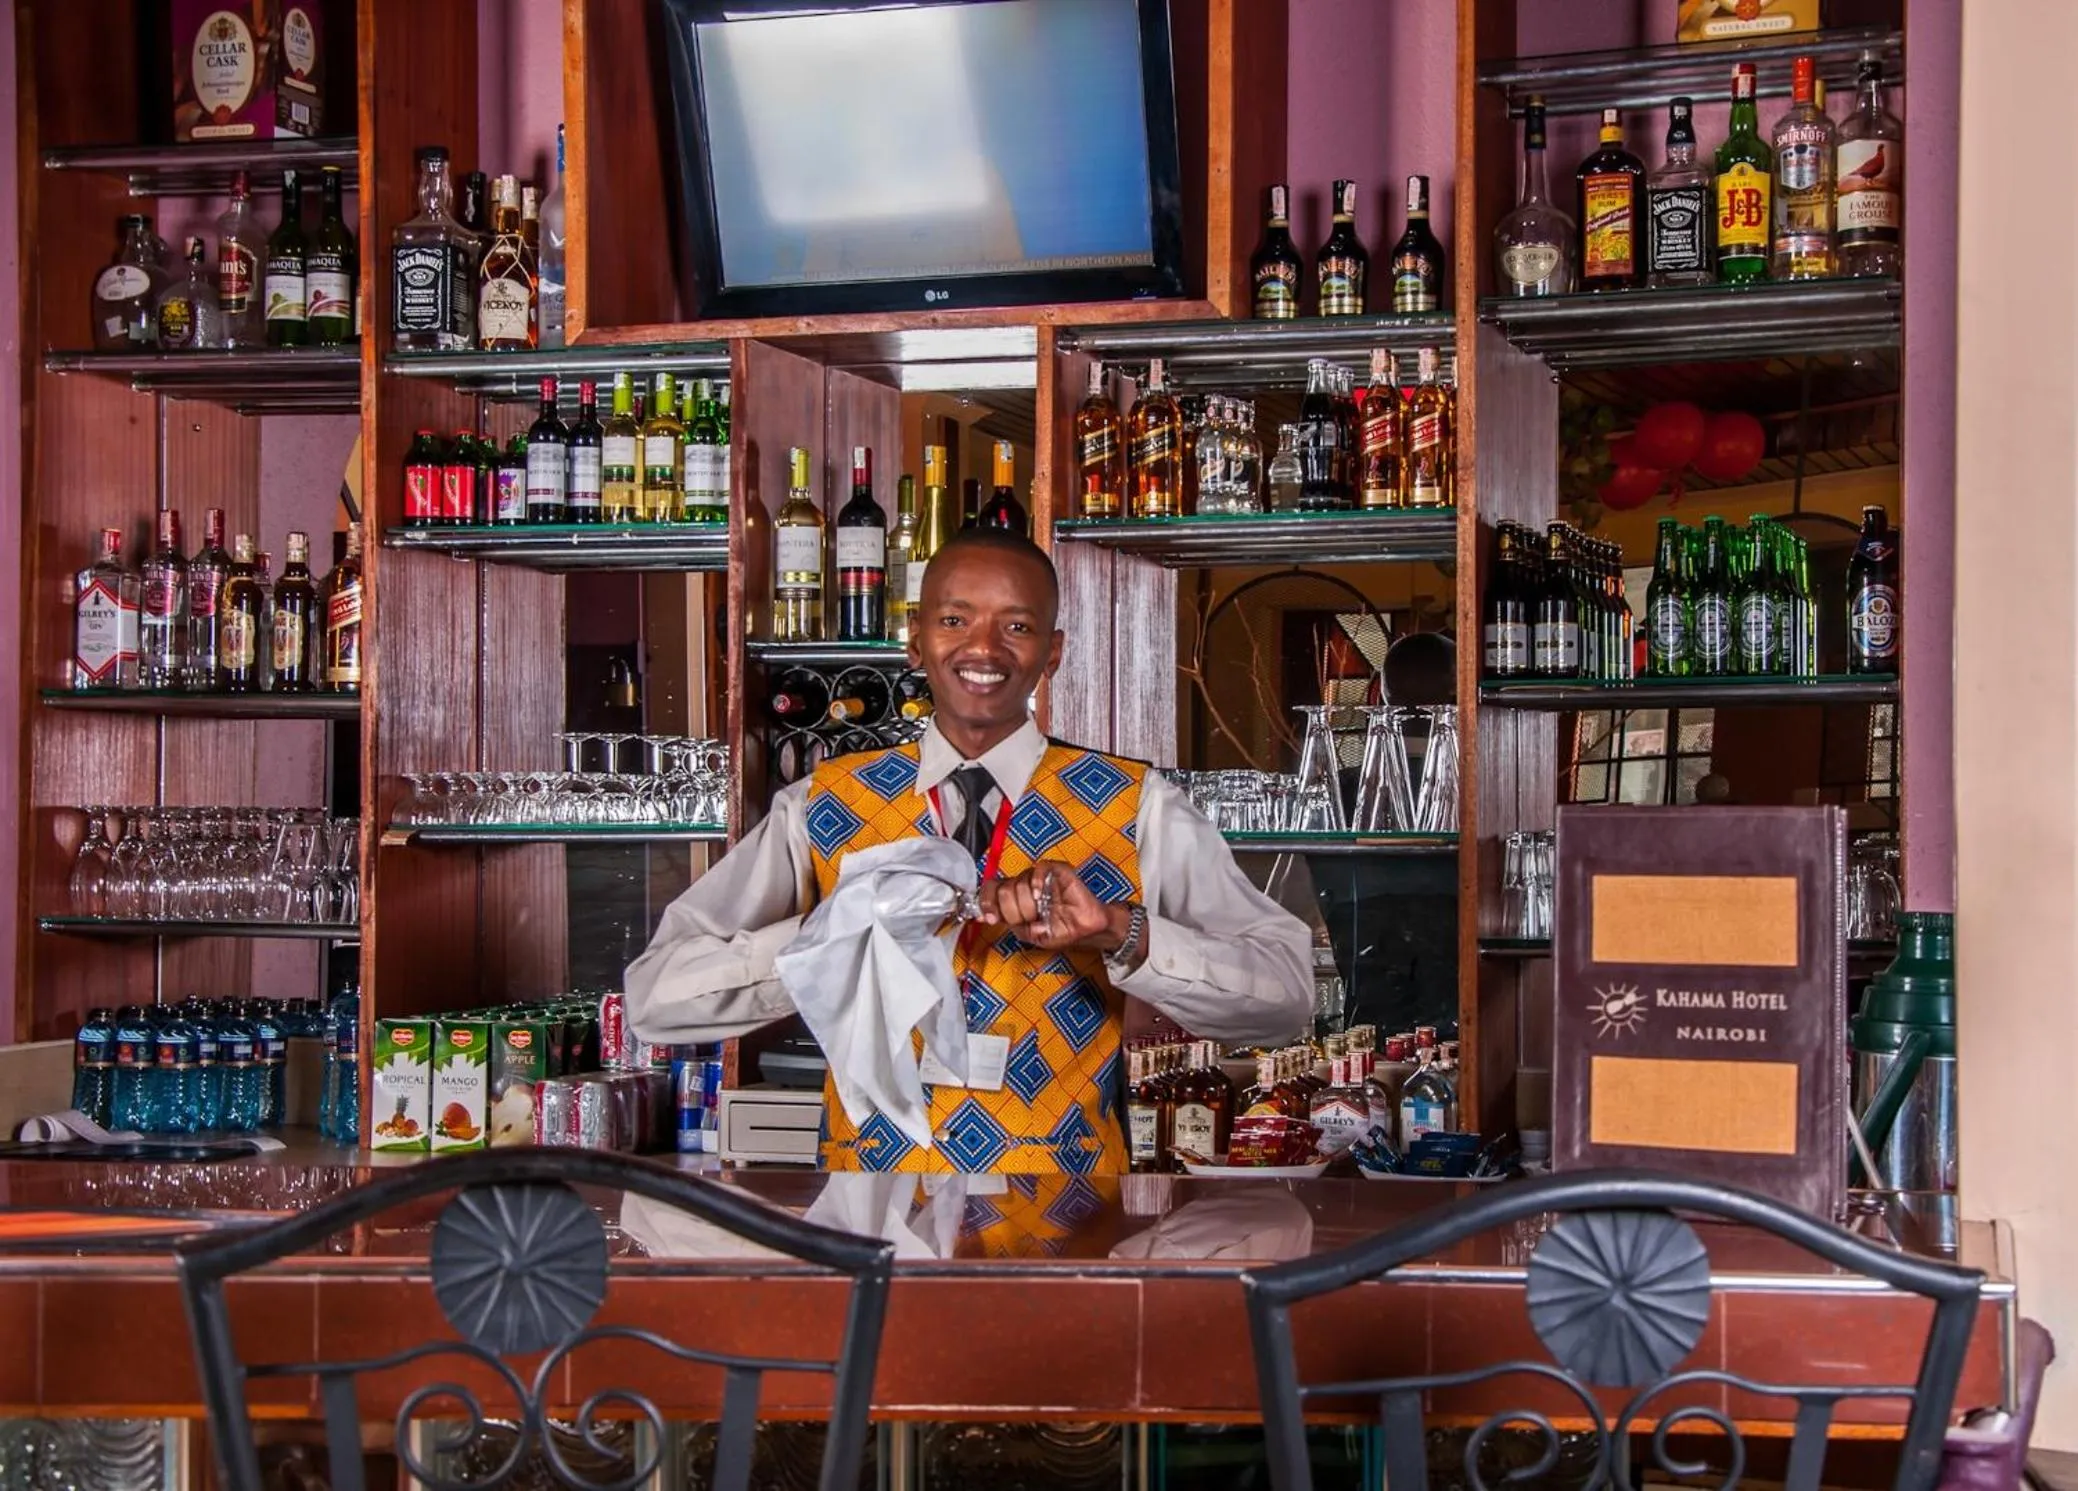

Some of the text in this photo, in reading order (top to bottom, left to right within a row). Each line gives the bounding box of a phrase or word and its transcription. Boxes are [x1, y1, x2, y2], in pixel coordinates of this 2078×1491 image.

[199, 42, 247, 56] CELLAR
[206, 55, 239, 68] CASK
[1776, 130, 1826, 146] SMIRNOFF
[1653, 200, 1672, 215] JACK
[1722, 188, 1763, 229] J&B
[220, 261, 247, 275] ant's
[937, 291, 949, 299] LG
[1857, 616, 1895, 627] BALOZ
[1656, 988, 1788, 1011] KAHAMA HOTEL
[1676, 1026, 1767, 1042] NAIROBI
[504, 1055, 536, 1065] APPLE
[441, 1076, 478, 1086] MANGO
[1178, 1123, 1212, 1133] VIEROY
